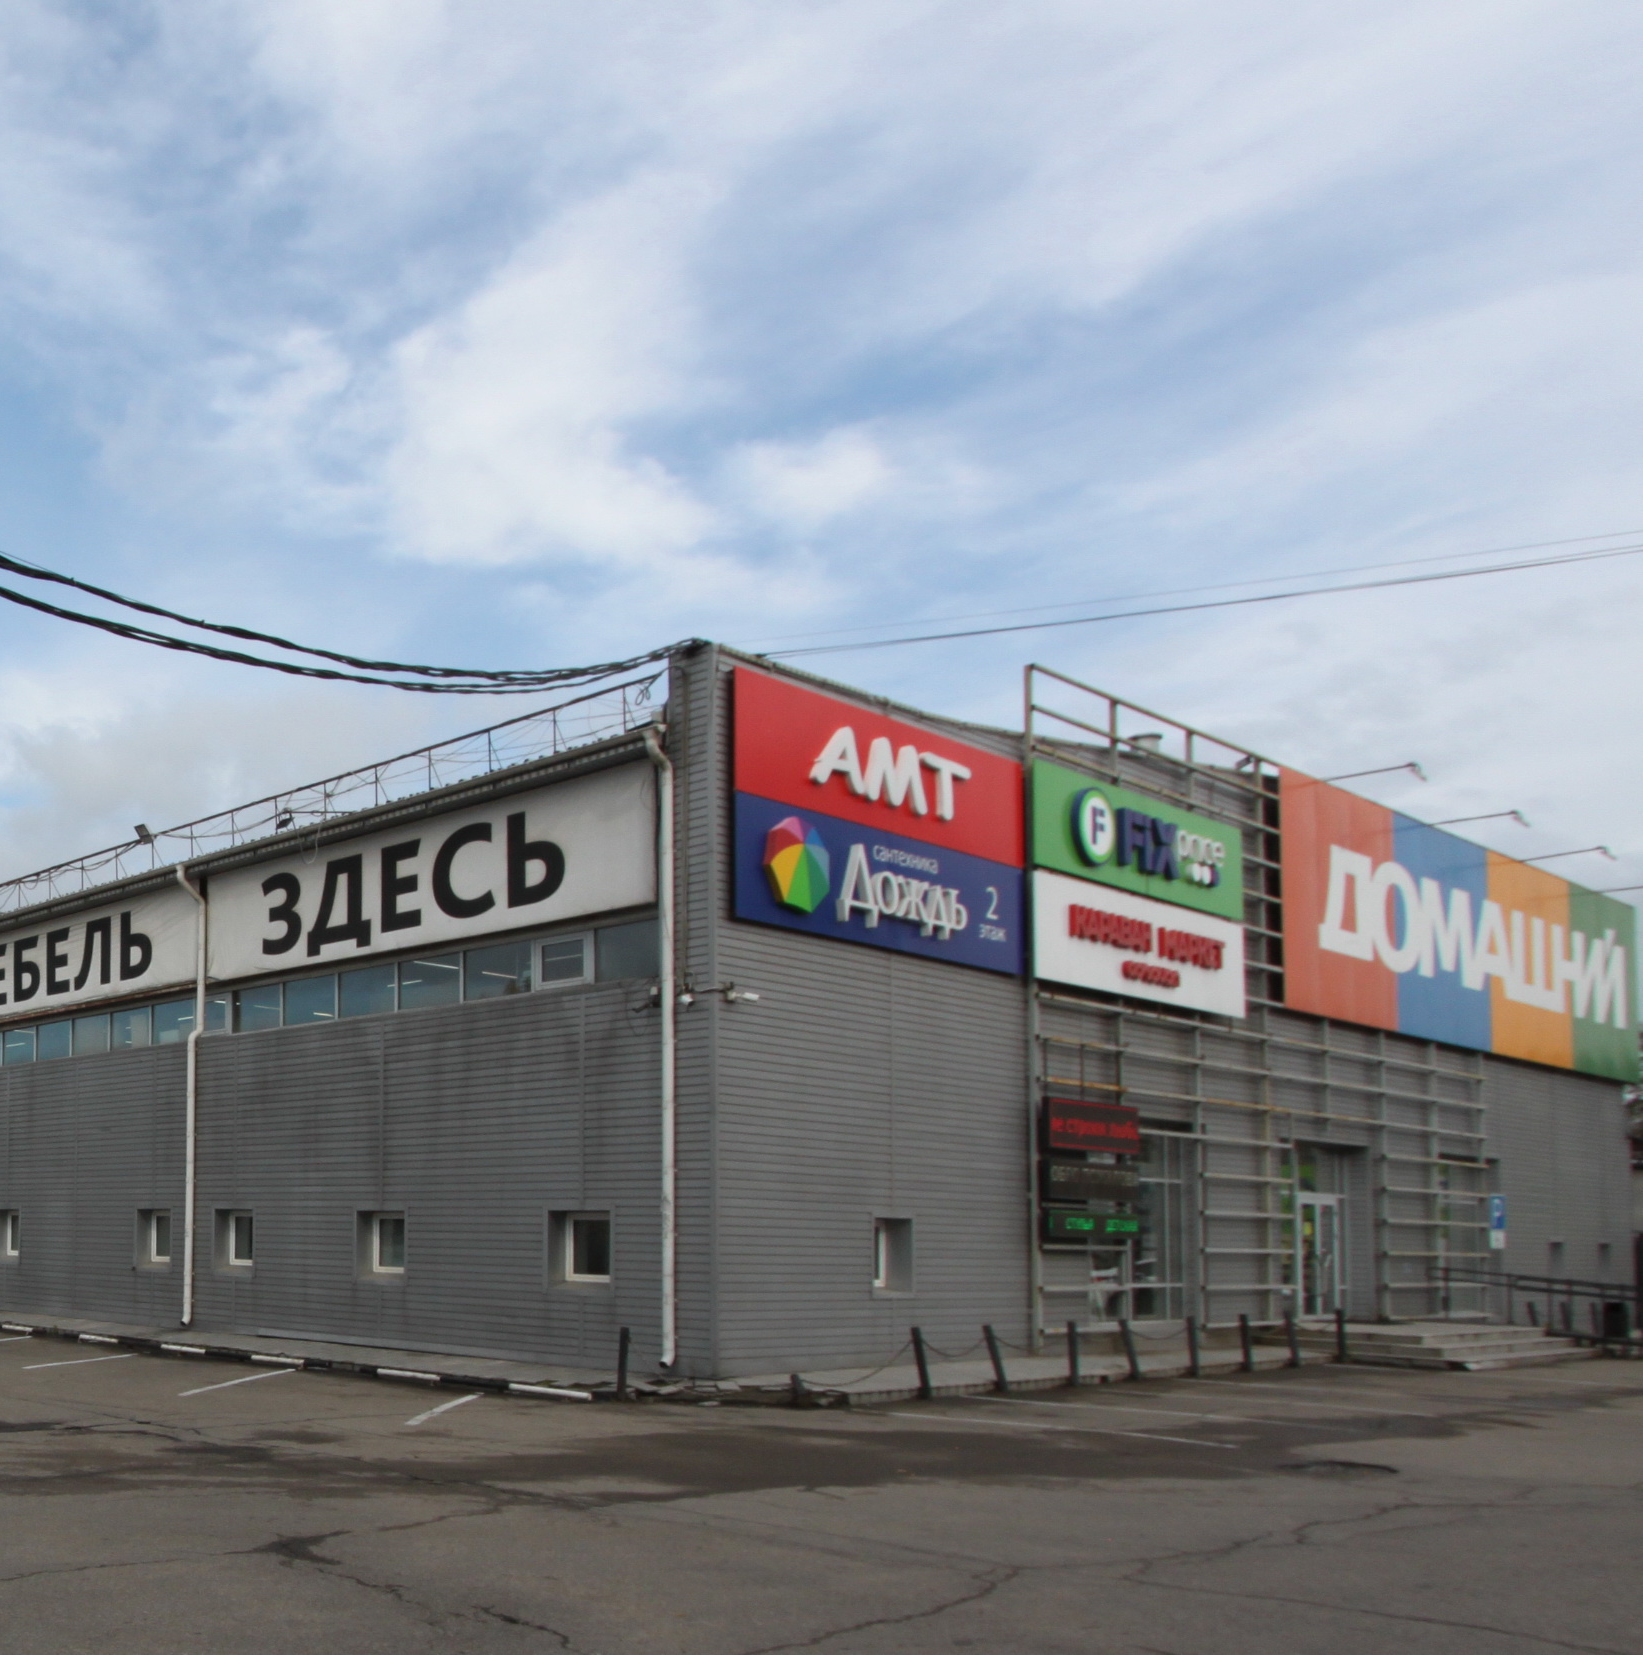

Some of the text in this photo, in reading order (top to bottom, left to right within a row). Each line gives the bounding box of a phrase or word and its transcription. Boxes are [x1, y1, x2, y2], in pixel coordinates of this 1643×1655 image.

[809, 725, 971, 822] АМТ
[260, 811, 566, 958] ЗДЕСЬ
[873, 842, 939, 876] сантехника
[979, 923, 1007, 943] этаж
[985, 886, 999, 921] 2
[1318, 844, 1628, 1029] ДОМАШНИЙ
